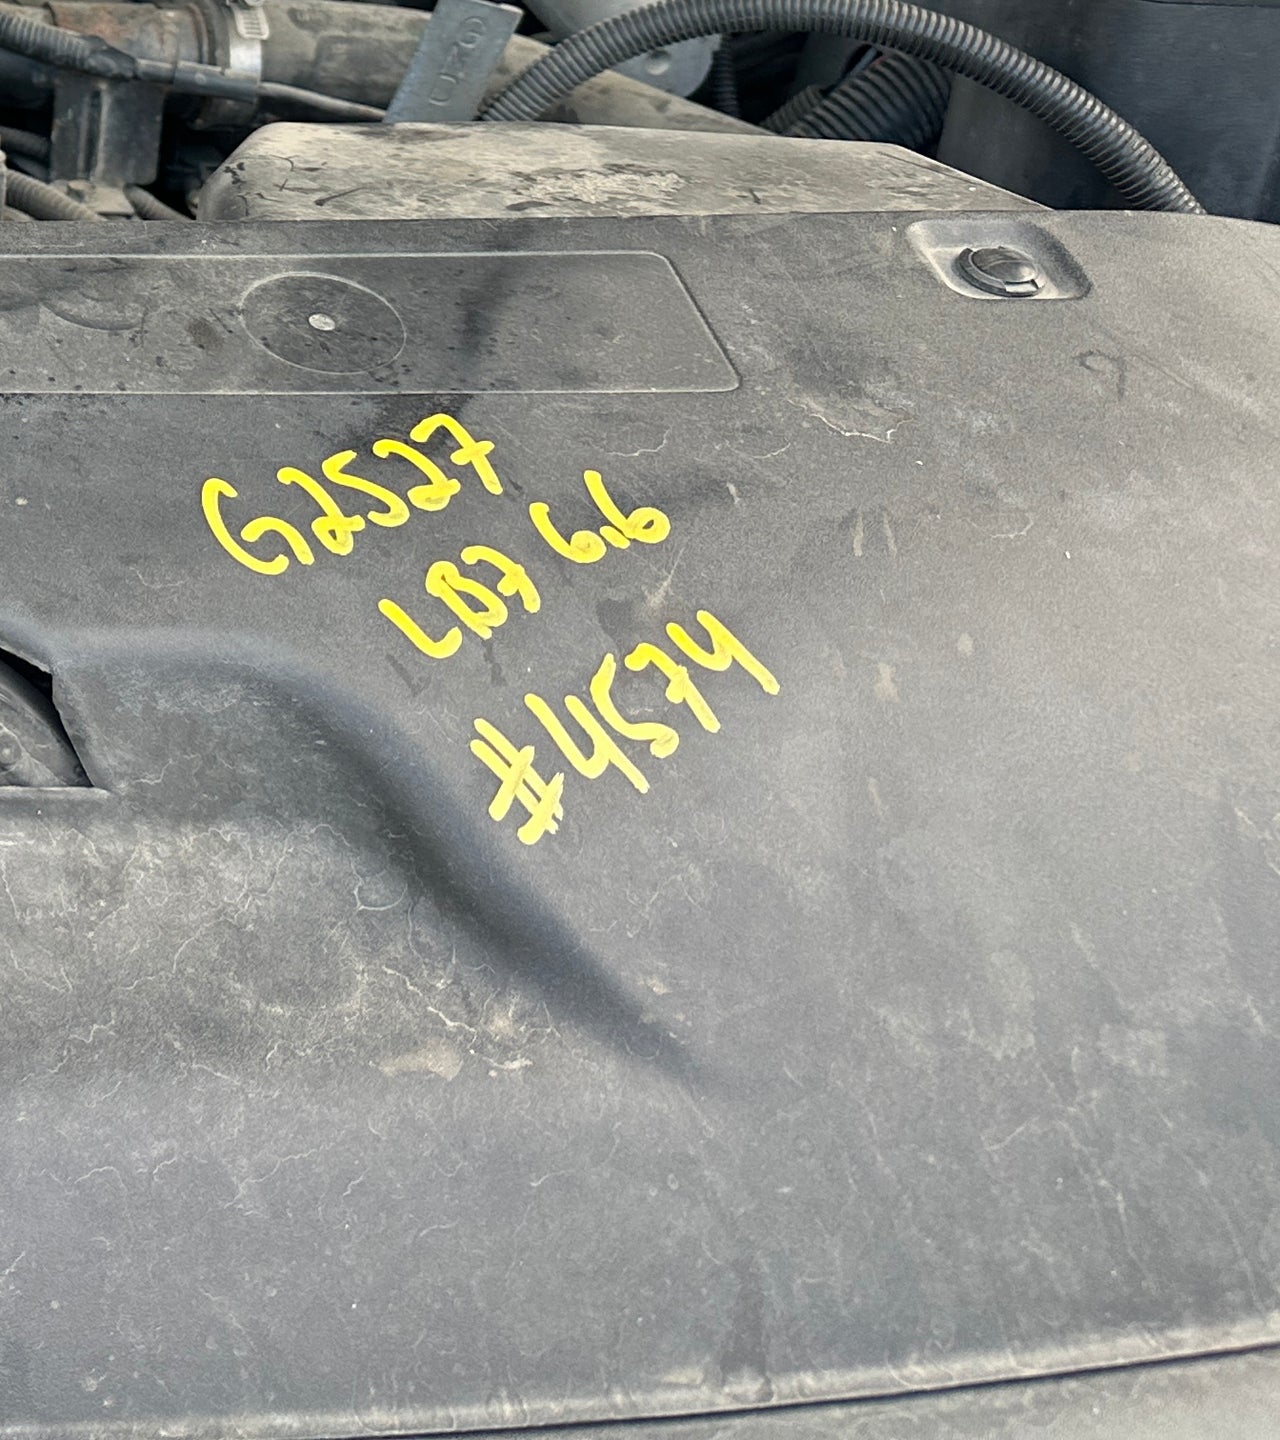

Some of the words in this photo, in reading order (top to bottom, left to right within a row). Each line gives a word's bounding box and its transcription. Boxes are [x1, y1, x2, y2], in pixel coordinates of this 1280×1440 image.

[201, 412, 504, 575] G2527
[529, 469, 671, 564] 6.6
[469, 610, 780, 846] #4574
